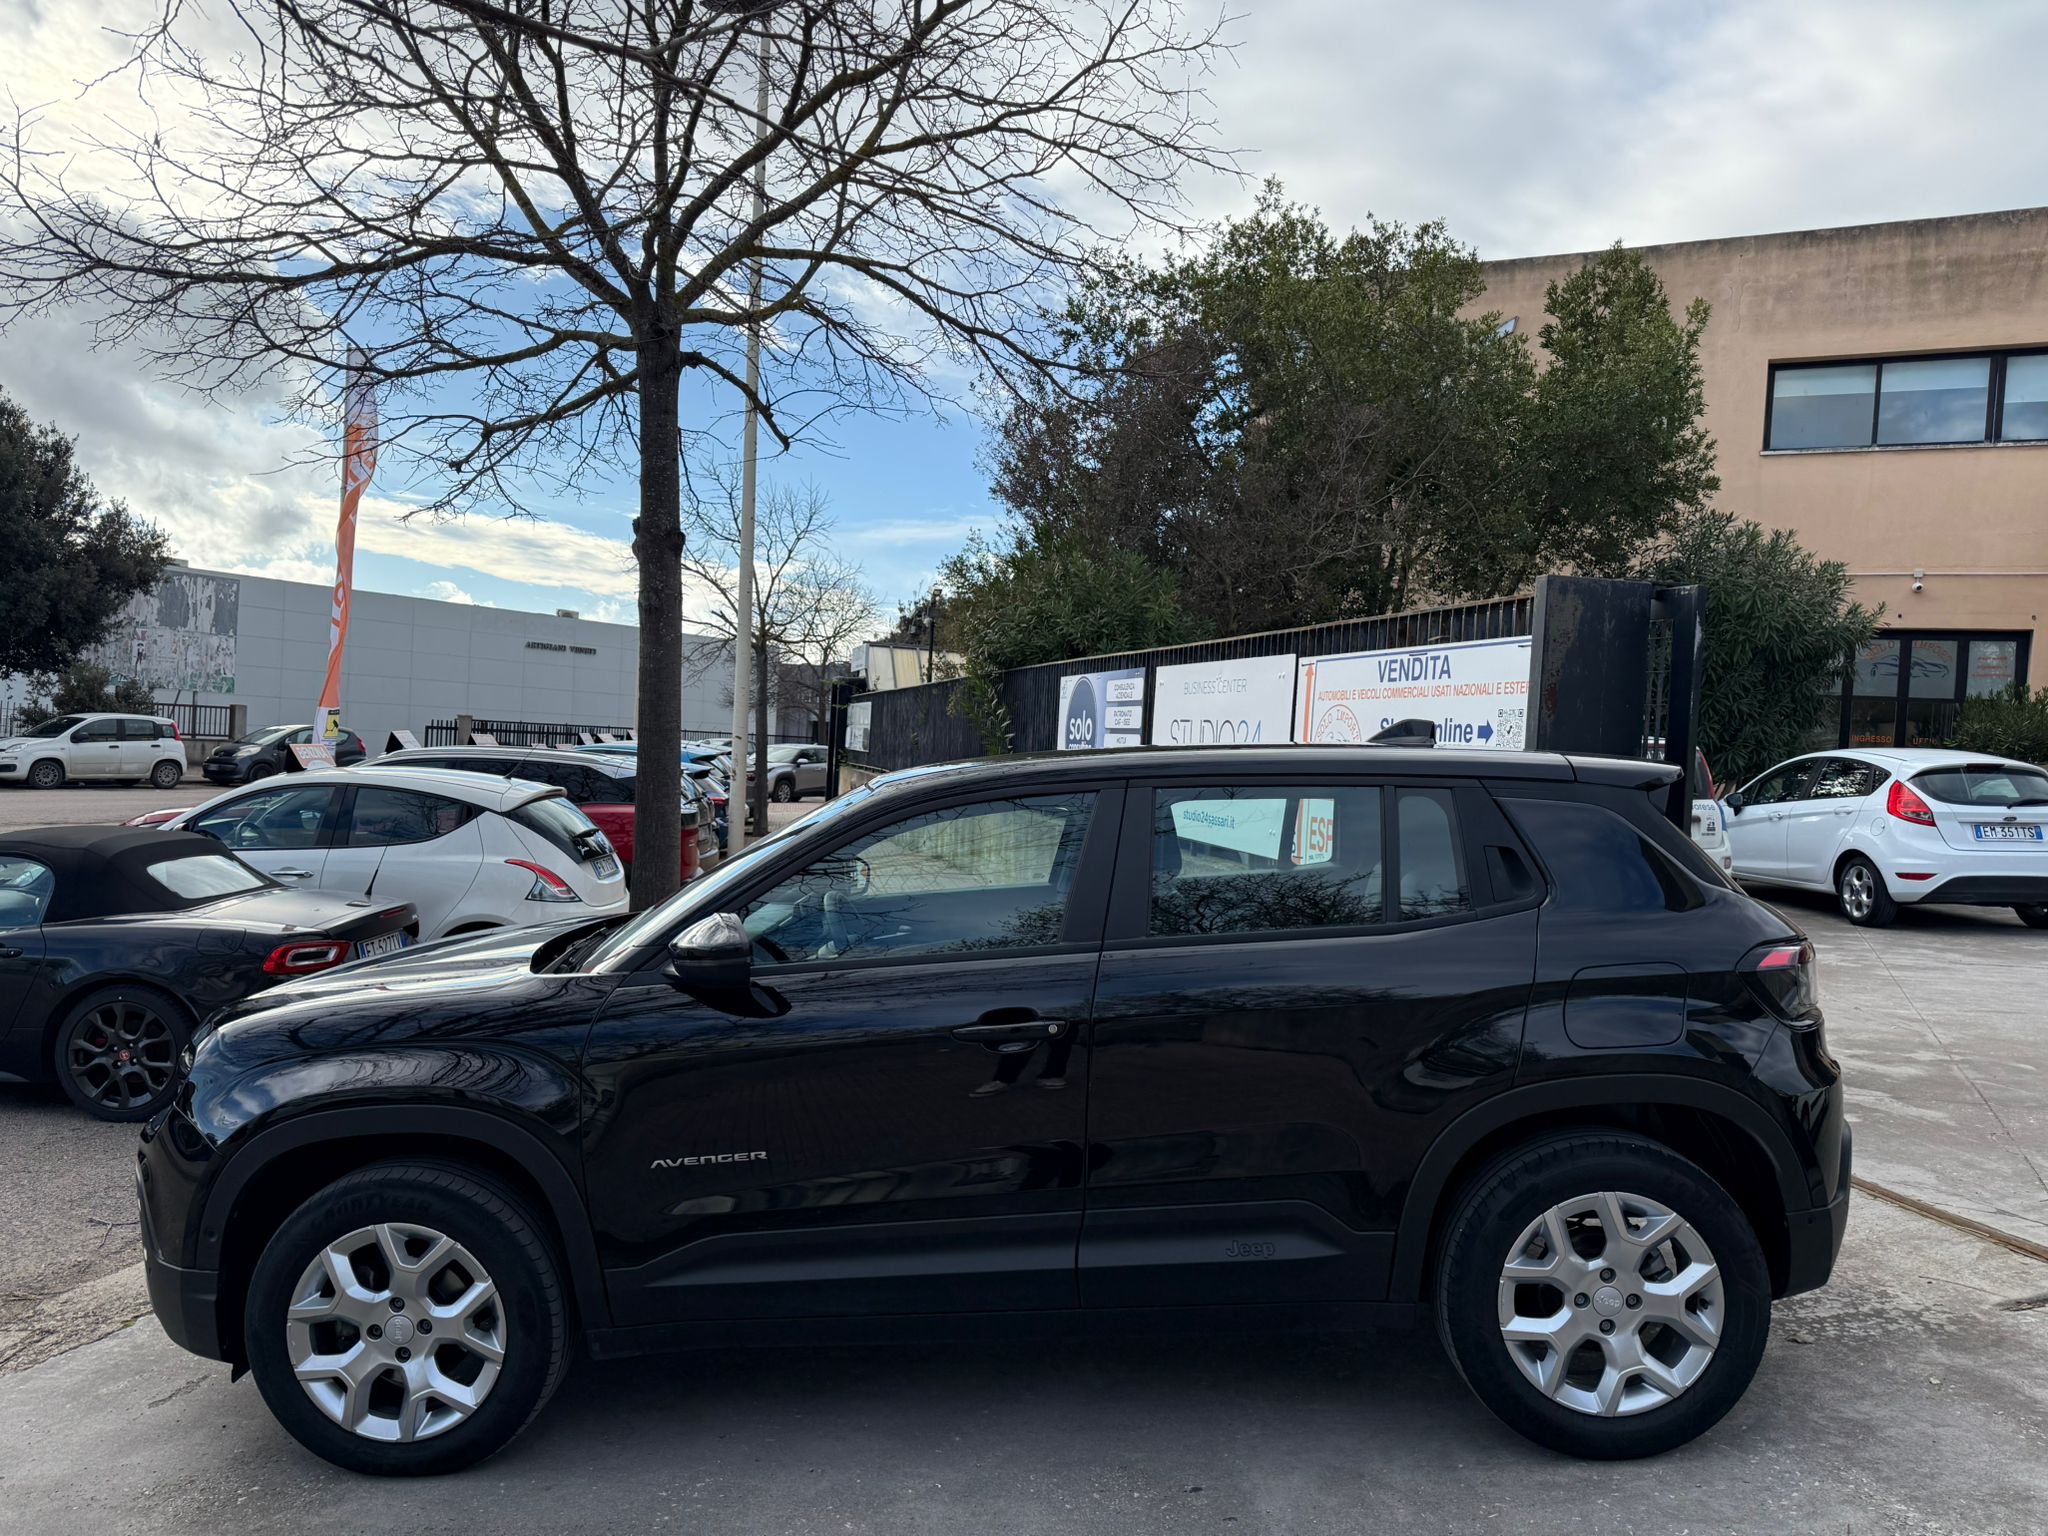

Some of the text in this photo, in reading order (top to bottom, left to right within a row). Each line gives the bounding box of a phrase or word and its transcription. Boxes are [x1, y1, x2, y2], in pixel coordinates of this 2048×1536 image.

[1378, 654, 1451, 683] VENDITA
[1183, 679, 1248, 695] BUSINESS CENTER
[1318, 688, 1350, 701] AUTOMOBILI
[1352, 689, 1357, 700] E
[1358, 687, 1380, 700] VEICOLI
[1382, 684, 1430, 699] COMMERCIALI
[1431, 684, 1452, 698] USATI
[1453, 682, 1494, 697] NAZIONALI
[1496, 682, 1502, 695] E
[1069, 710, 1093, 741] solo
[1851, 735, 1892, 744] INGRESSO
[1183, 809, 1236, 830] studio24sassari.it
[1982, 826, 2035, 838] EM 351TS
[650, 1151, 768, 1168] AVENGER
[1225, 1240, 1275, 1258] Jeep
[1596, 1295, 1620, 1308] Jeep
